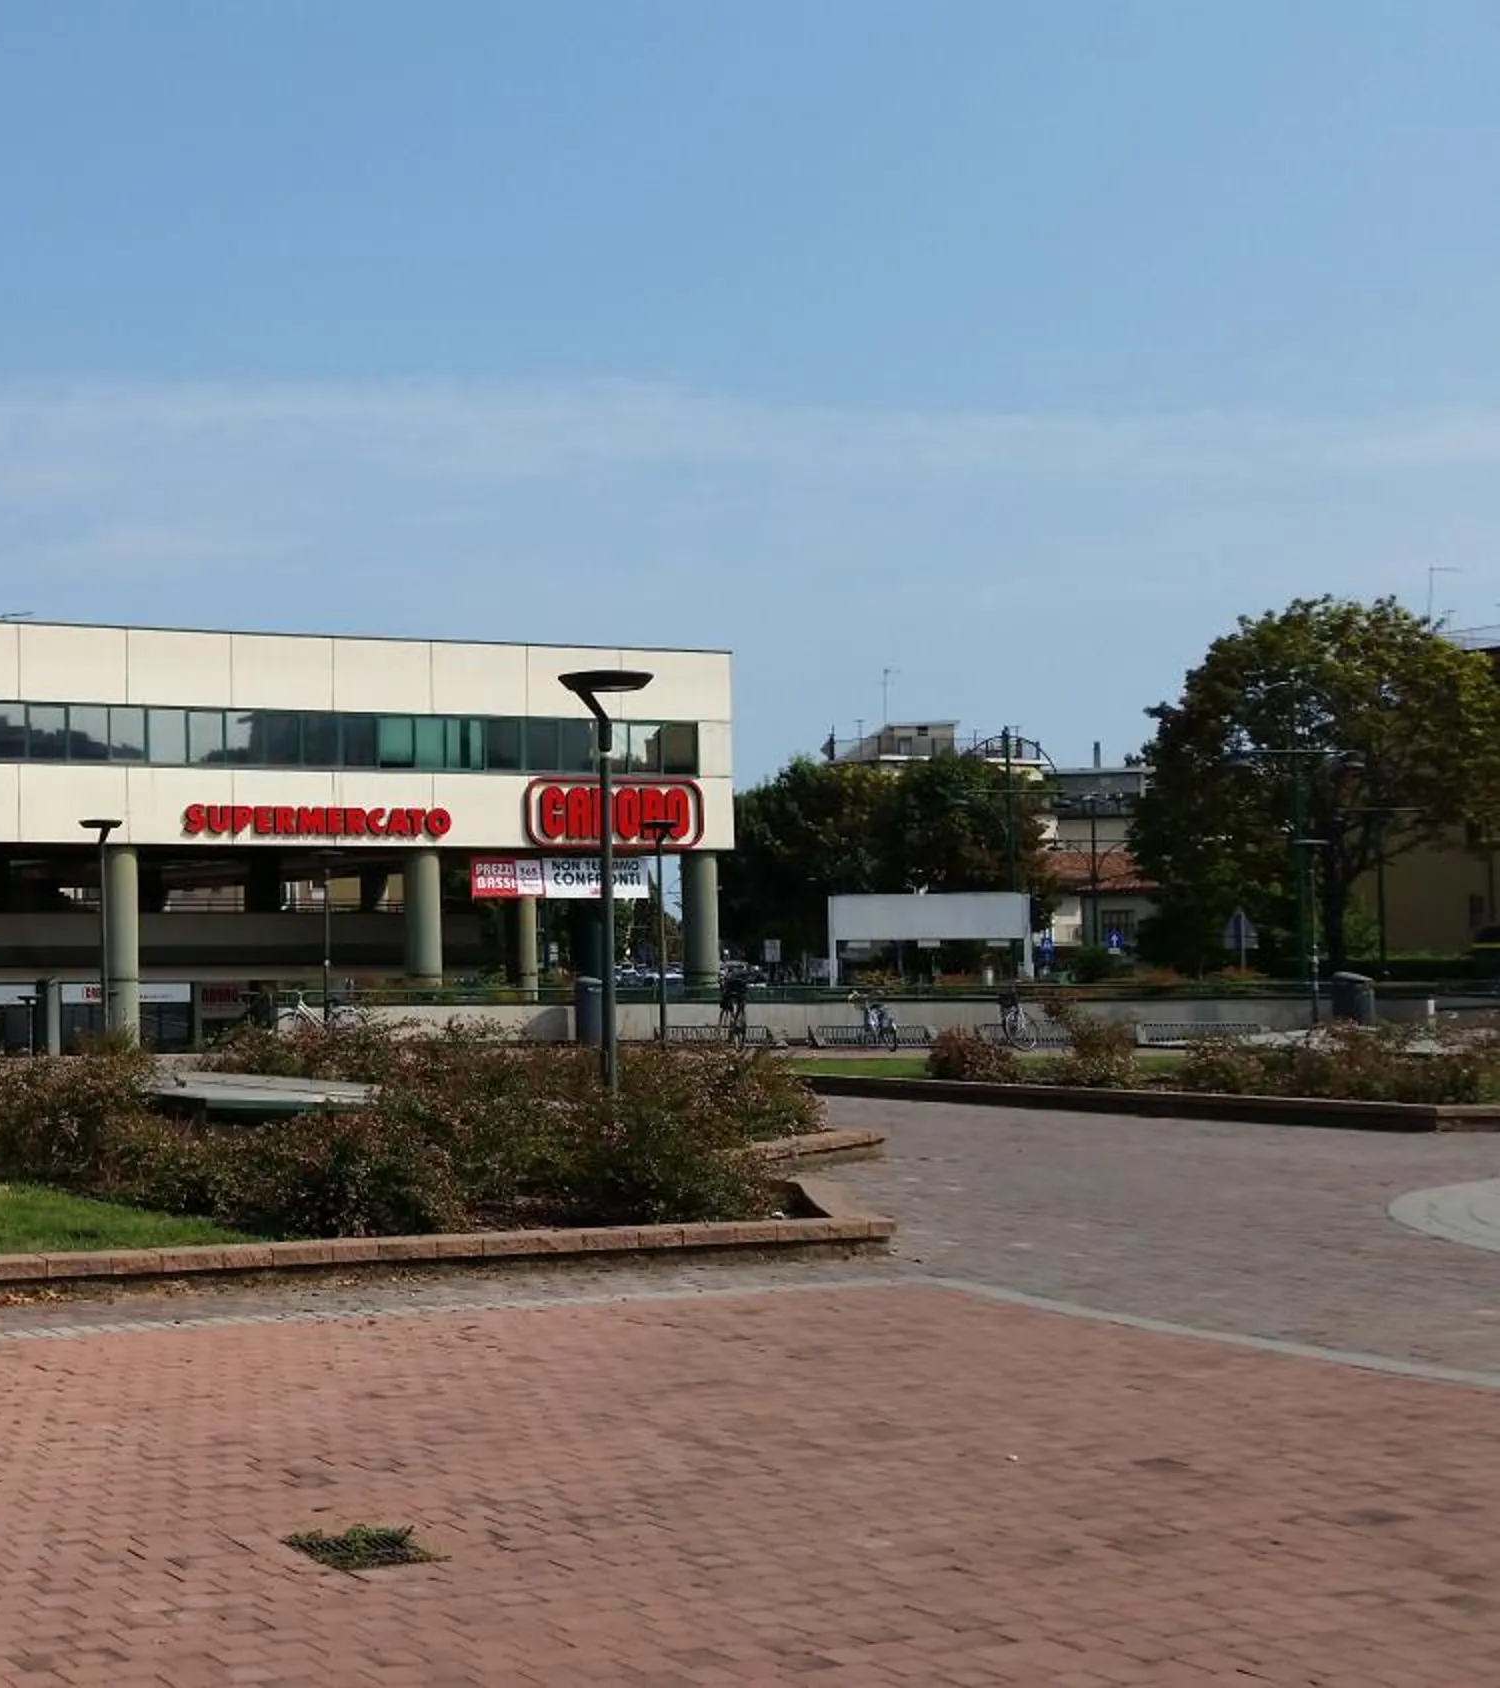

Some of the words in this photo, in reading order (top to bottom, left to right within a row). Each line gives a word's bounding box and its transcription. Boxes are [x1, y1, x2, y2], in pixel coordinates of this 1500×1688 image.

[184, 804, 451, 837] SUPERMERCATO
[475, 863, 514, 877] PREZZI
[551, 860, 580, 871] NON
[585, 860, 640, 871] TEAMO
[477, 877, 517, 889] BASSI
